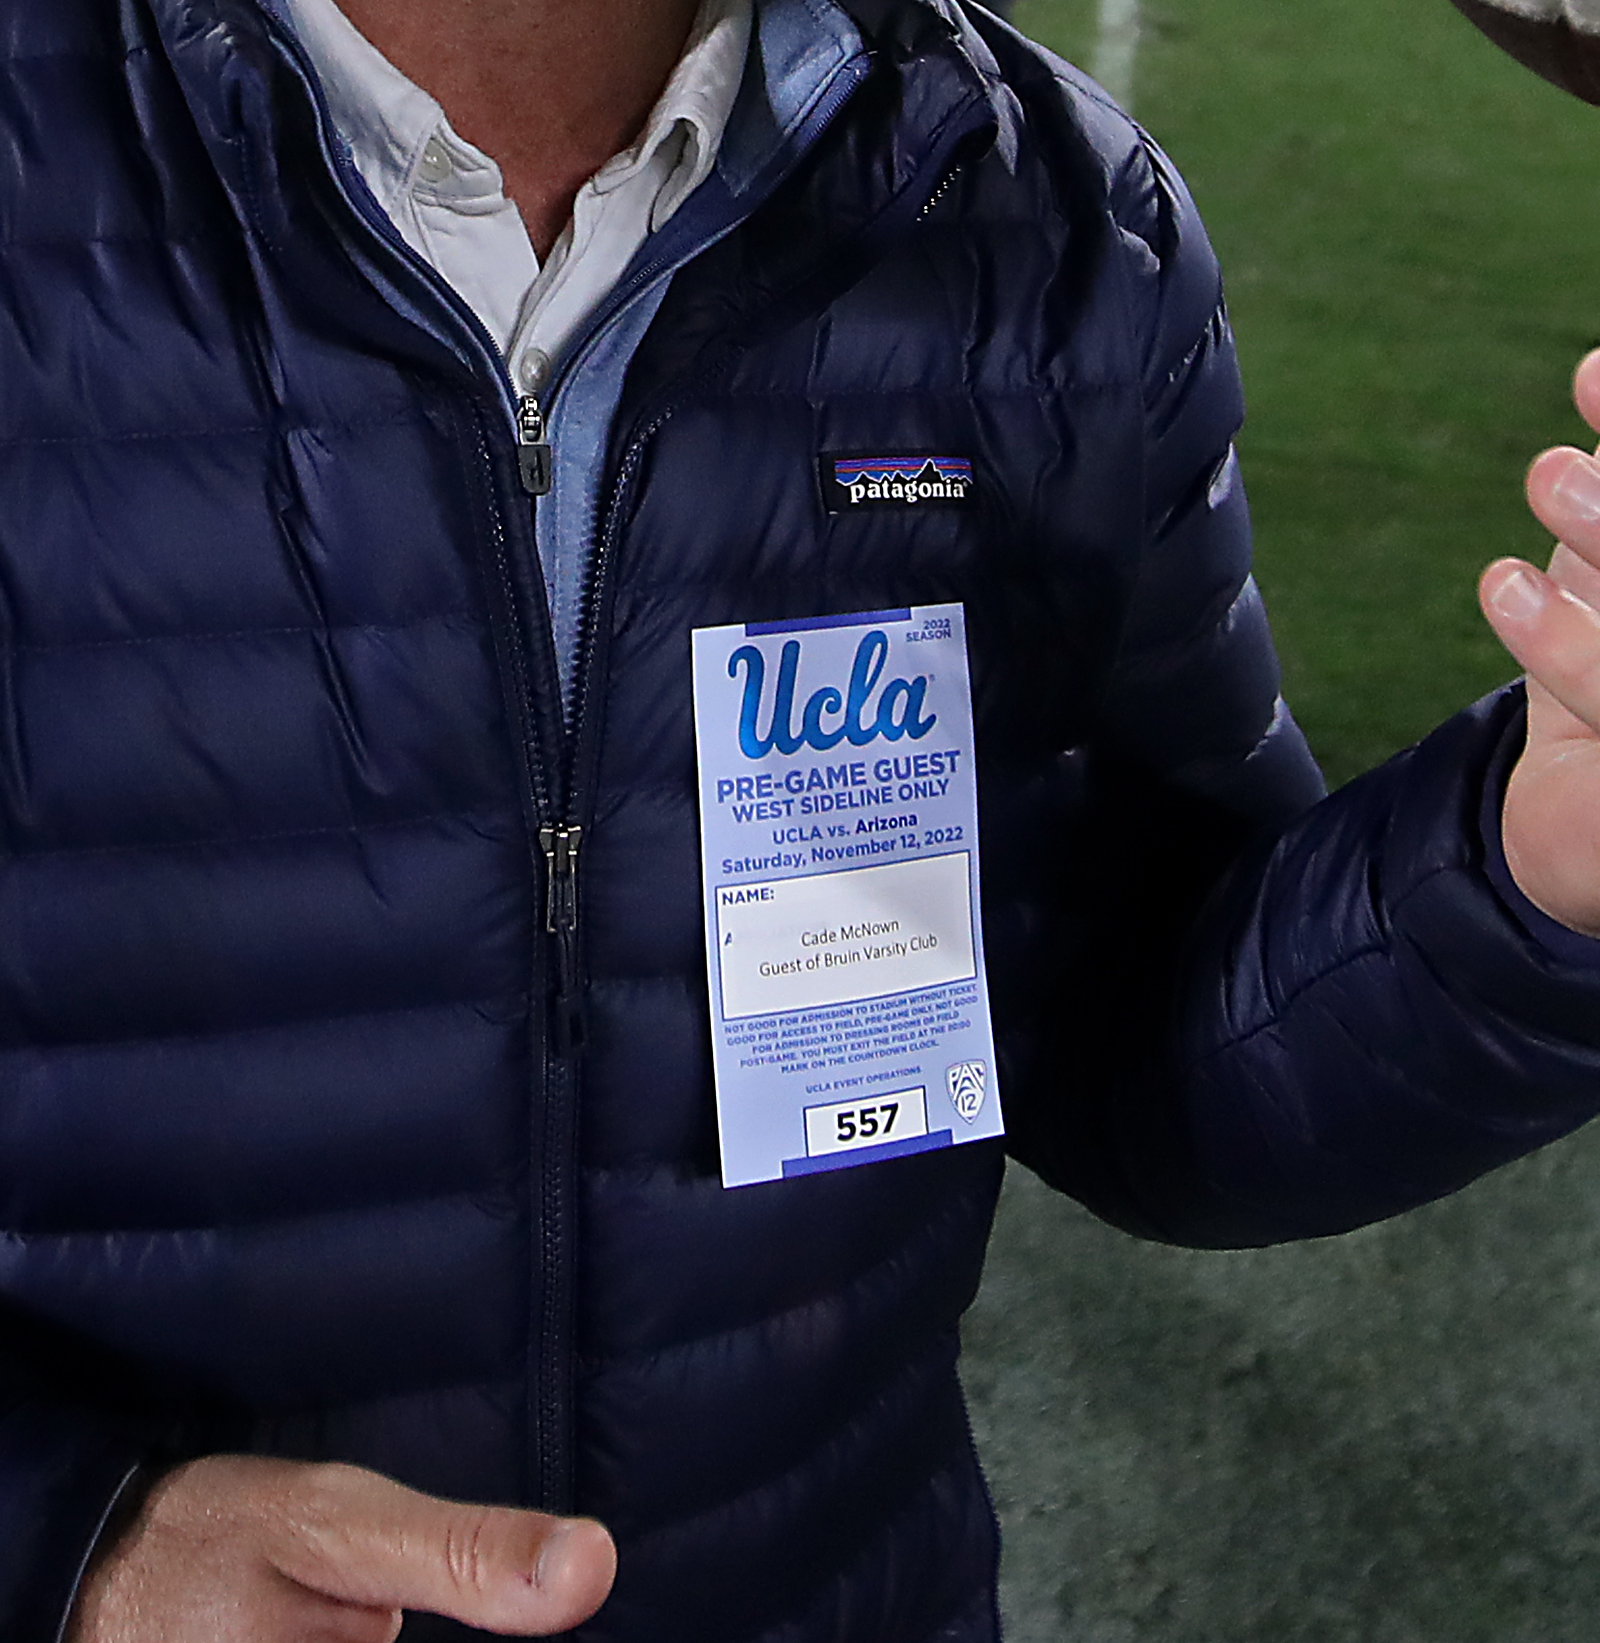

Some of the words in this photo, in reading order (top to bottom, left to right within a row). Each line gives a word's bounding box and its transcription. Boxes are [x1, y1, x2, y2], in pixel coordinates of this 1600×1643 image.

[850, 479, 965, 503] patagonia
[906, 628, 951, 643] SEASON
[923, 618, 951, 630] 2022
[727, 630, 937, 759] Ucla
[717, 762, 867, 803] PRE-GAME
[873, 750, 961, 782] GUEST
[732, 799, 795, 824] WEST
[801, 788, 892, 815] SIDELINE
[899, 778, 949, 802] ONLY
[773, 825, 822, 844] UCLA
[828, 825, 850, 838] vs.
[856, 813, 918, 835] Arizona
[722, 850, 806, 874] Saturday,
[812, 836, 896, 863] November
[900, 832, 920, 851] 12,
[925, 826, 963, 845] 2022
[722, 889, 775, 905] NAME:
[801, 928, 836, 947] Cade
[840, 919, 900, 941] McNown
[759, 959, 802, 977] Guest
[805, 956, 820, 971] of
[825, 951, 861, 967] Bruin
[864, 941, 908, 961] Varsity
[910, 933, 938, 951] Club
[806, 1082, 831, 1095] UCLA
[834, 1076, 863, 1089] EVENT
[867, 1065, 921, 1085] OPERATIONS
[837, 1102, 899, 1142] 557
